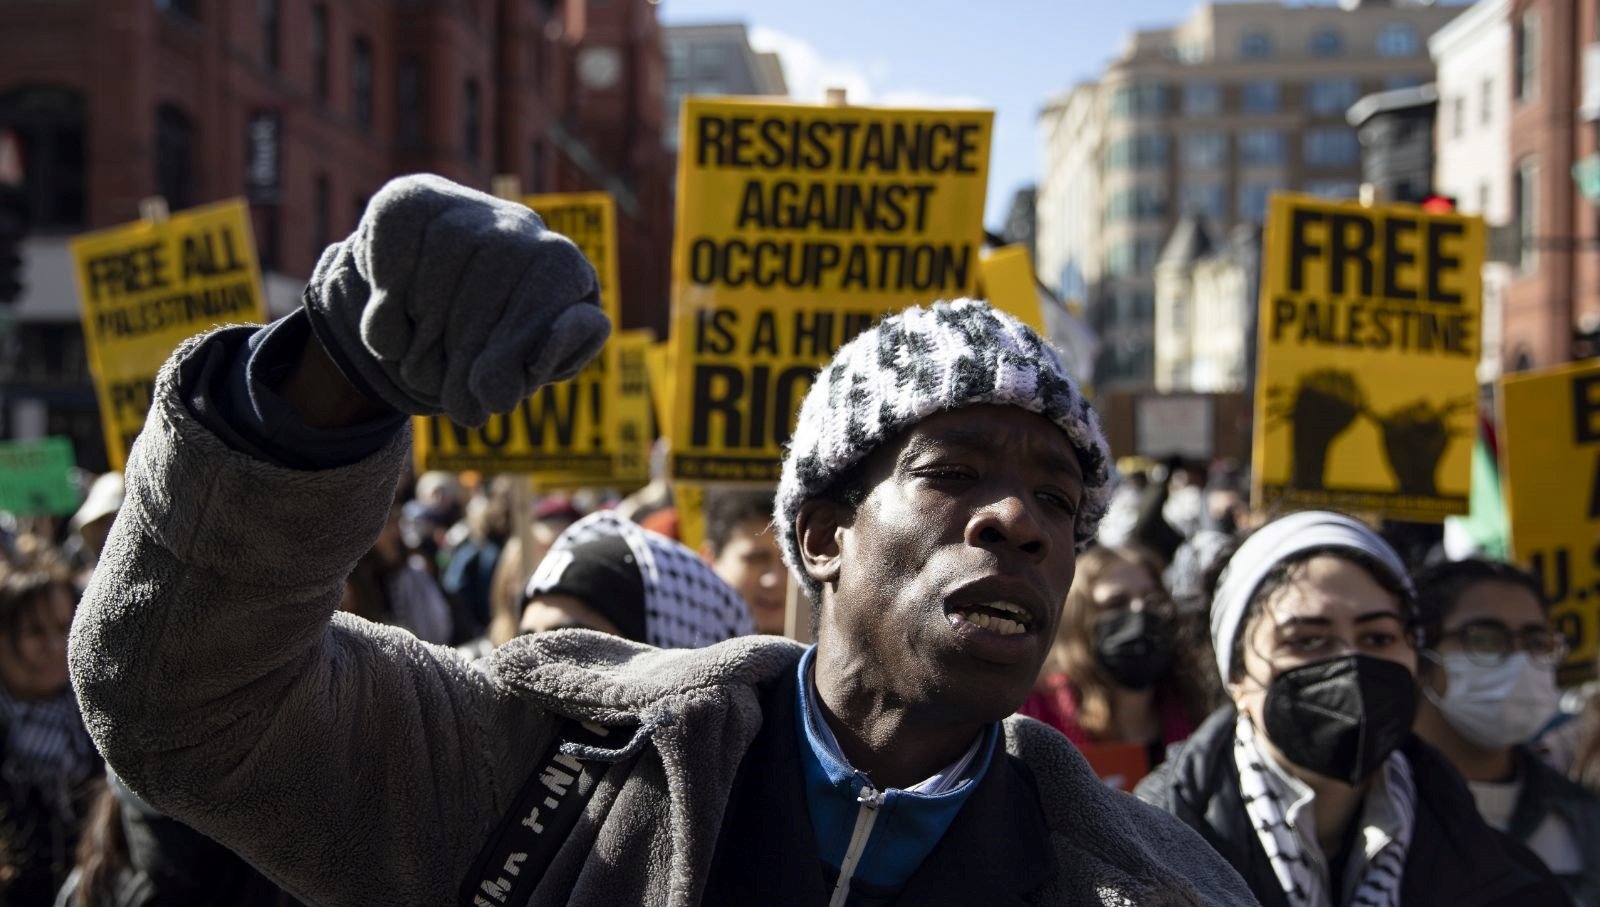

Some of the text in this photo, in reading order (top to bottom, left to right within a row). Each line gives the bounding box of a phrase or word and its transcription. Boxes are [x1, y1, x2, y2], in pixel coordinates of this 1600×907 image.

[695, 115, 981, 176] RESISTANCE
[737, 180, 935, 233] AGAINST
[88, 222, 247, 299] FREE ALL
[690, 238, 972, 292] OCCUPATION
[1288, 208, 1464, 305] FREE
[97, 281, 256, 342] PALESTINIAN
[696, 310, 740, 356] IS
[750, 312, 781, 356] A
[1271, 301, 1472, 357] PALESTINE
[427, 384, 604, 447] NOW!
